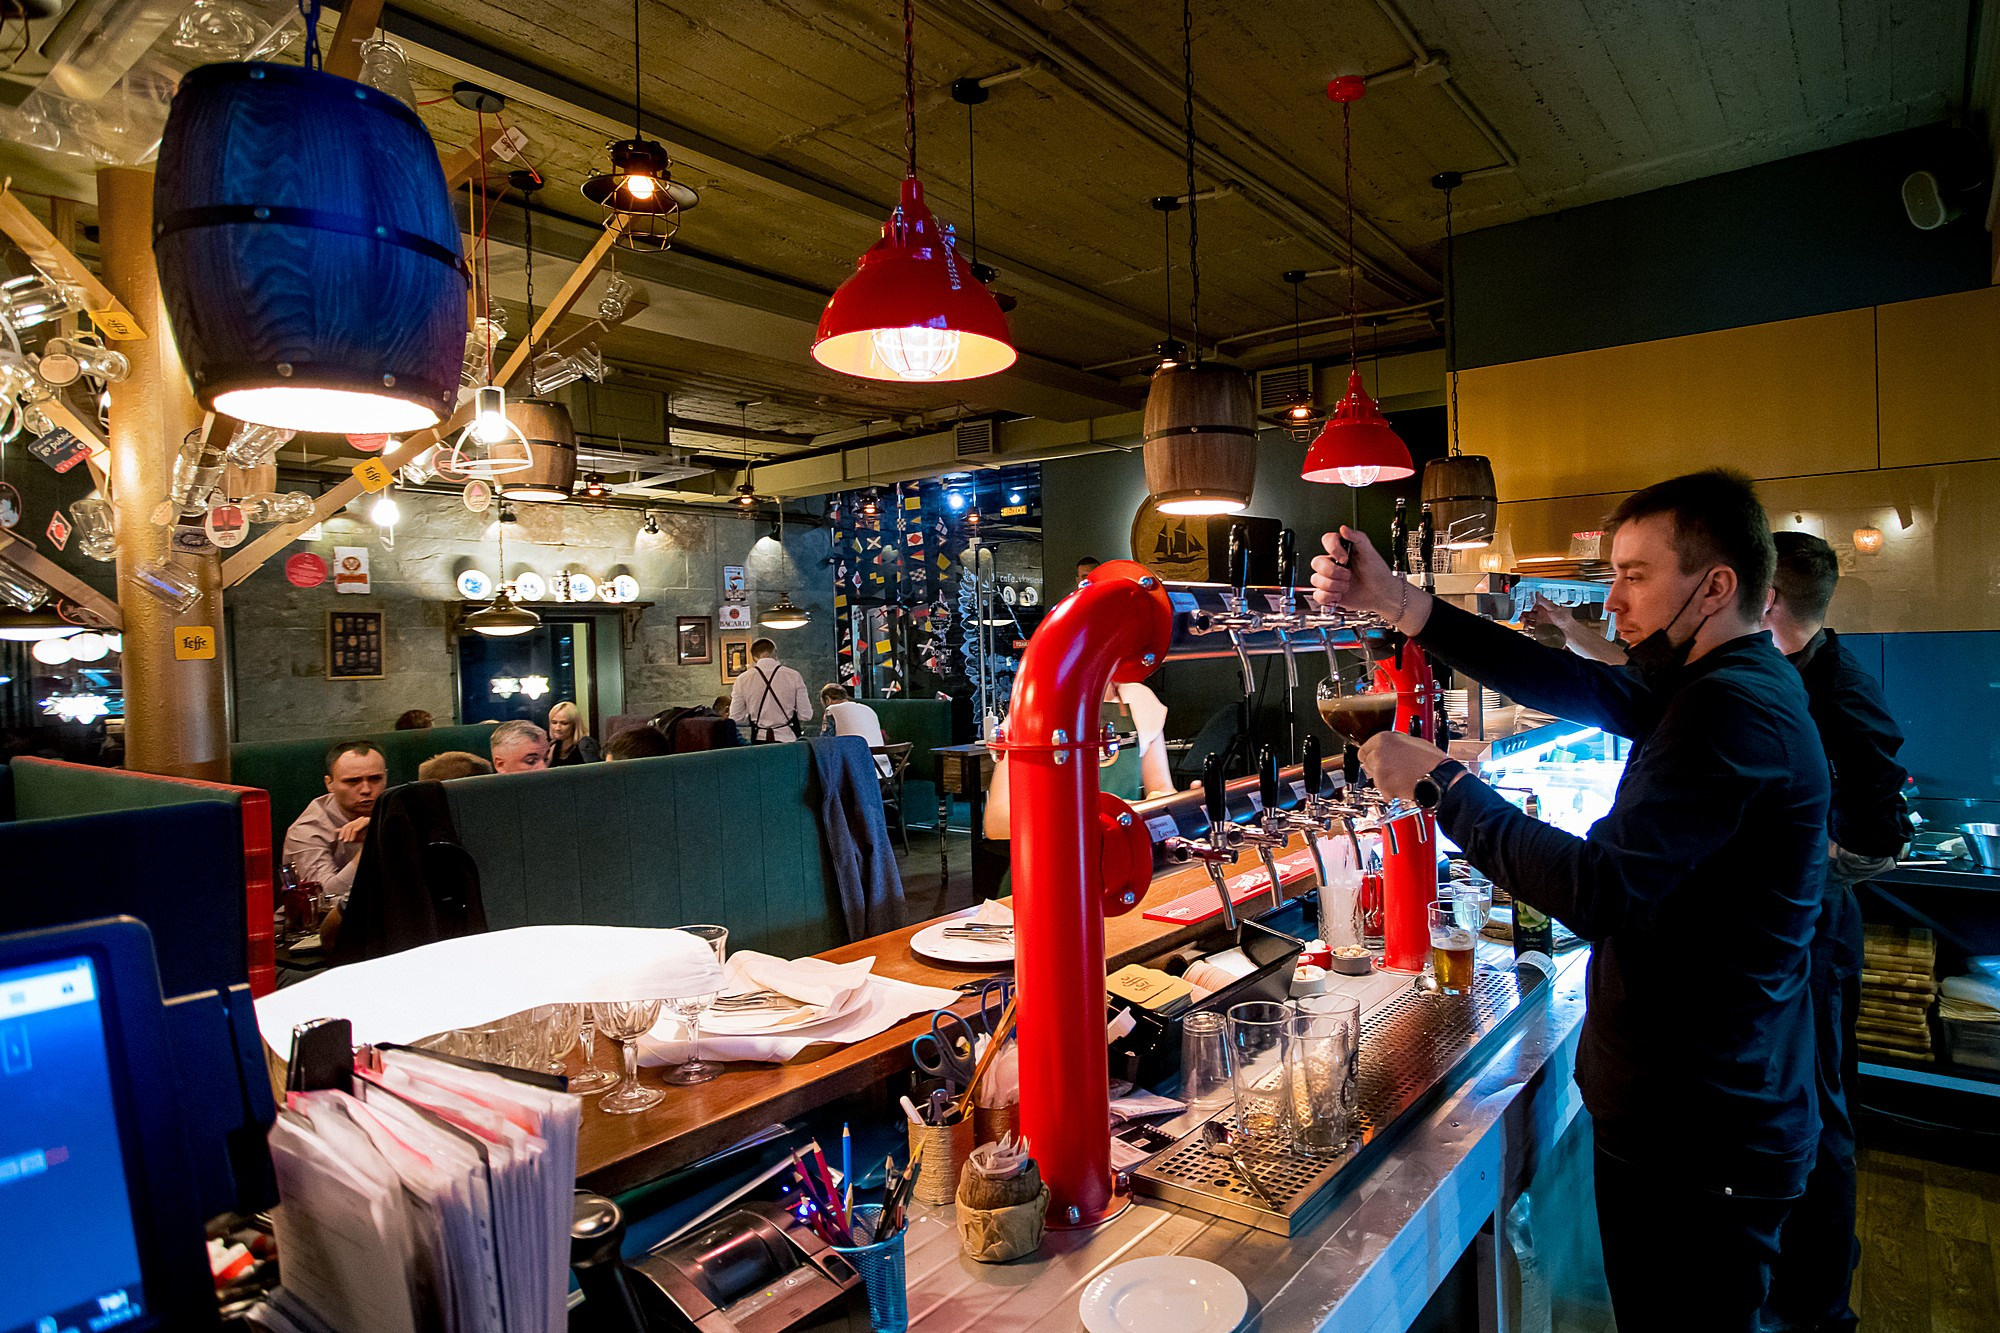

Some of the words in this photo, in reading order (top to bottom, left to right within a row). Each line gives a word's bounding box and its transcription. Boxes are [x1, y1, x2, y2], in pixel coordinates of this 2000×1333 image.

[50, 432, 73, 450] public
[183, 635, 207, 651] Leffe
[1120, 975, 1155, 992] Leffe
